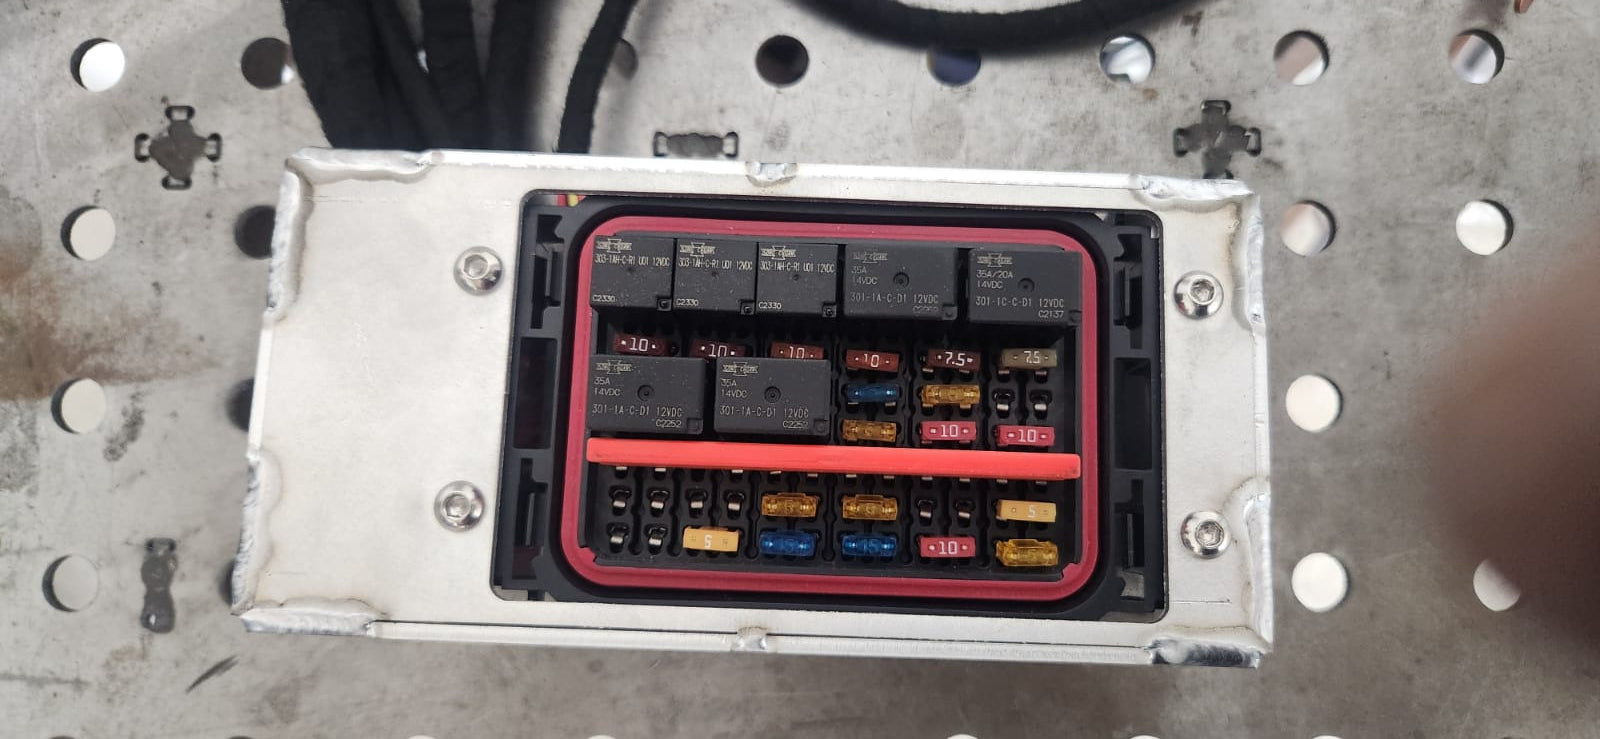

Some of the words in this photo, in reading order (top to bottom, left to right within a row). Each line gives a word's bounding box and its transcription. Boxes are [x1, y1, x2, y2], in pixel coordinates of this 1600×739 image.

[851, 265, 867, 274] 35A
[976, 269, 1014, 279] 35A/20A
[977, 281, 1004, 289] 14VDC
[850, 292, 907, 303] 301-1A-C-D1
[913, 294, 939, 304] 12VDC
[1039, 298, 1065, 308] 12VDC
[758, 301, 782, 310] C2330
[1038, 310, 1065, 318] C2137
[629, 337, 649, 352] 10
[863, 353, 880, 368] 10
[944, 351, 966, 367] 7.5
[593, 376, 611, 385] 35A
[720, 378, 737, 387] 35A
[594, 387, 621, 396] 14VDC
[721, 389, 747, 398] 14VDC
[591, 404, 650, 415] 301-1A-C-D1
[656, 406, 682, 417] 12VDC
[784, 408, 809, 418] 12VDC
[655, 419, 682, 428] C2252
[940, 424, 959, 438] 10
[1017, 429, 1037, 443] 10
[1027, 504, 1037, 518] 5
[704, 534, 713, 549] 5
[938, 540, 958, 555] 10
